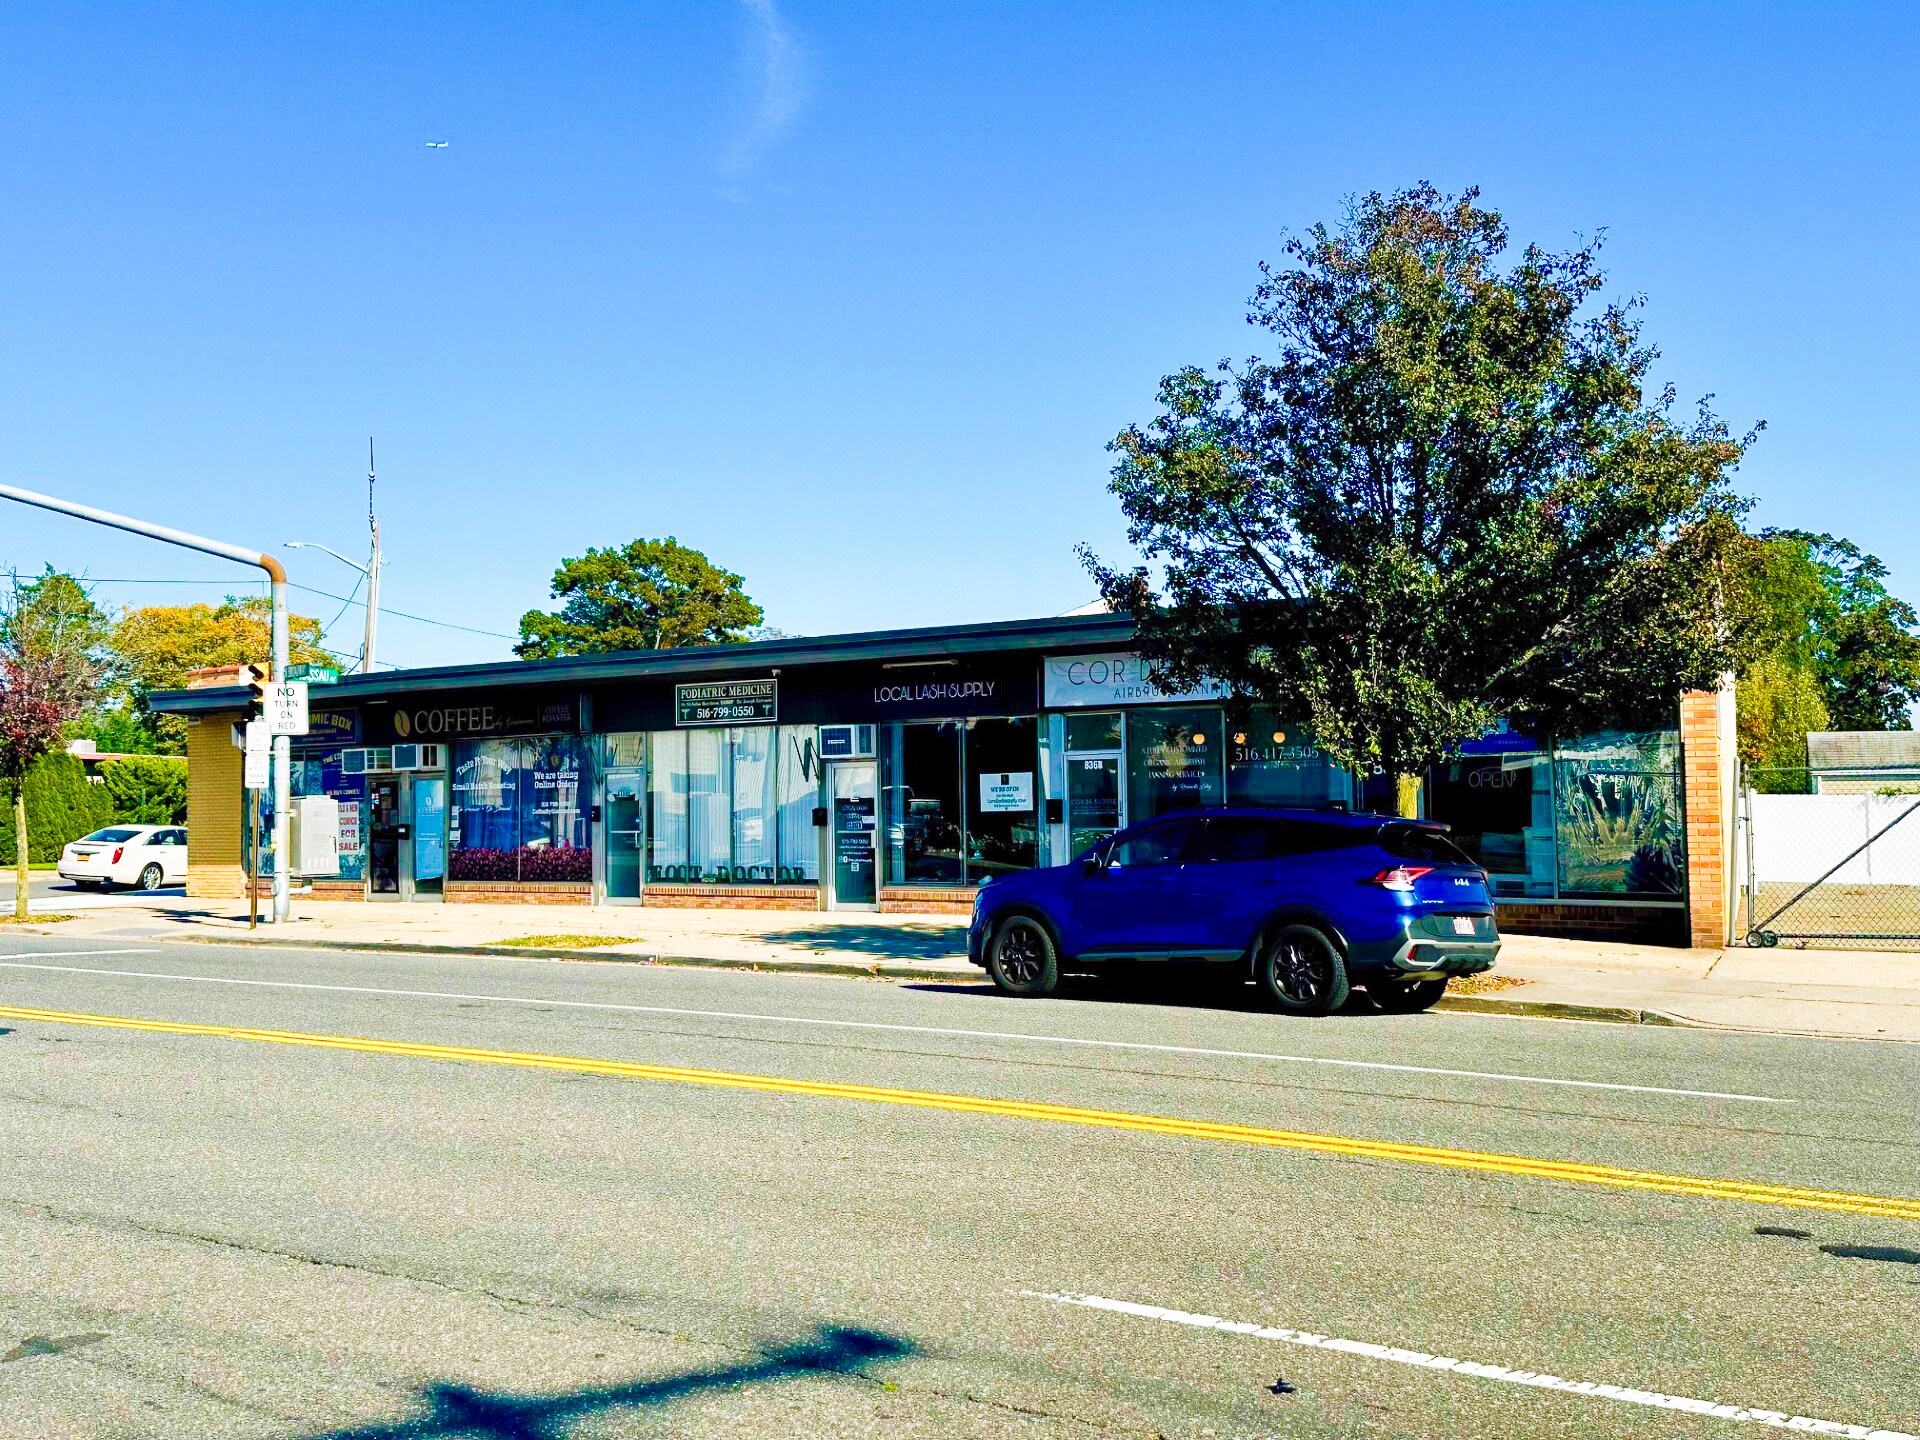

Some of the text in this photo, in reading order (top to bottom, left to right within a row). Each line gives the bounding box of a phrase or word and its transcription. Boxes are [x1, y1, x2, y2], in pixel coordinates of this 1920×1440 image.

[1067, 660, 1126, 686] COR
[277, 687, 295, 697] NO
[681, 684, 773, 699] PODIATRIC MEDICINE
[874, 681, 995, 703] LOCAL LASH SUPPLY
[274, 700, 298, 708] TURN
[280, 711, 293, 719] ON
[697, 705, 754, 719] 516-799-0550
[278, 722, 296, 730] RED
[331, 714, 352, 731] BOX
[414, 706, 495, 734] COFFEE
[1235, 746, 1319, 762] 516.417.3505
[456, 760, 474, 776] Taste
[534, 771, 545, 780] We
[557, 771, 579, 780] taking
[1468, 770, 1513, 788] OPEN
[452, 783, 470, 791] Small
[534, 781, 556, 789] Online
[340, 829, 356, 839] FOR
[338, 842, 358, 851] SALE
